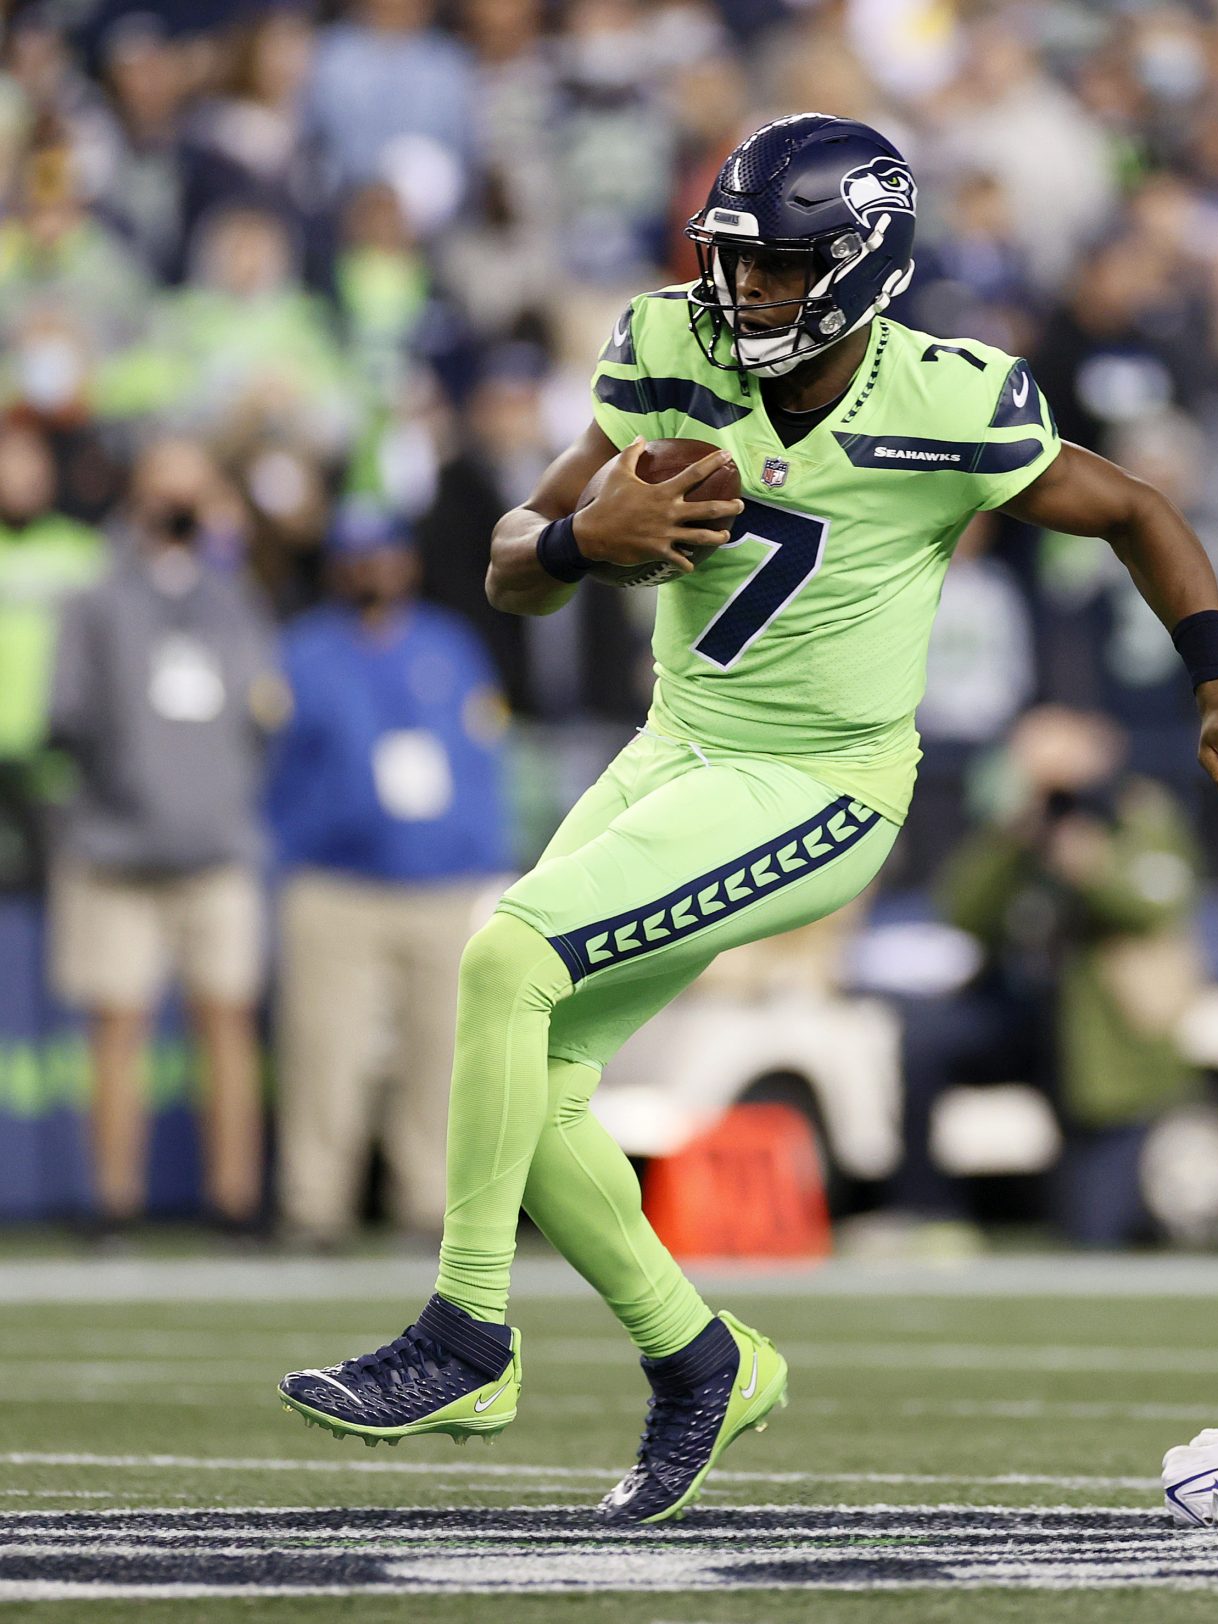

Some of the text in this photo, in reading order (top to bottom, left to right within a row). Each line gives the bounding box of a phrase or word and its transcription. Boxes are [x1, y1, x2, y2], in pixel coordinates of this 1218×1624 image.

[921, 344, 987, 371] 7
[874, 447, 961, 462] SEAHAWKS
[689, 495, 832, 672] 7
